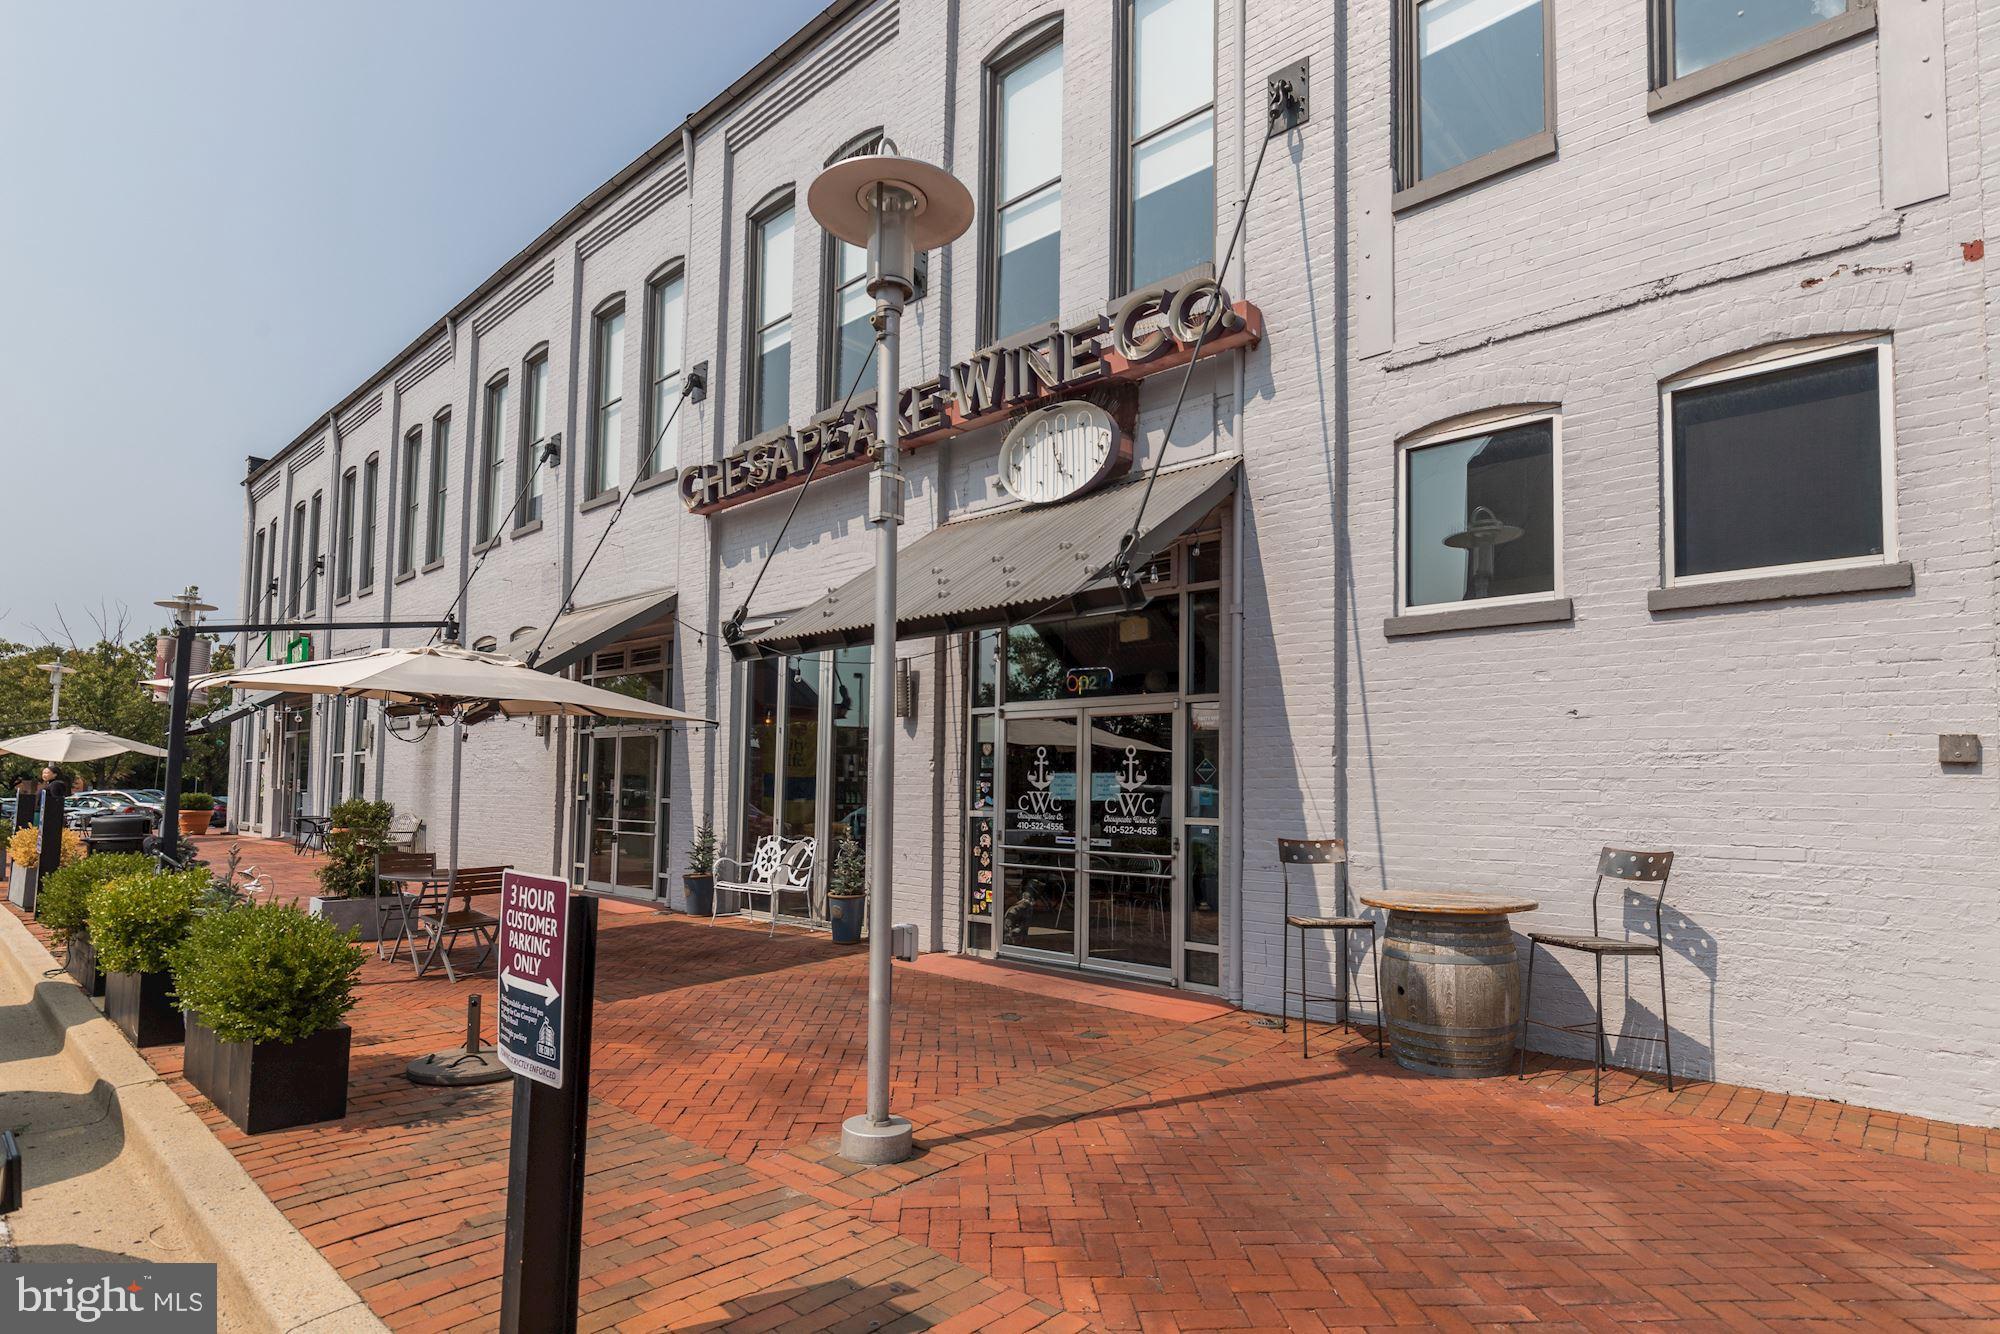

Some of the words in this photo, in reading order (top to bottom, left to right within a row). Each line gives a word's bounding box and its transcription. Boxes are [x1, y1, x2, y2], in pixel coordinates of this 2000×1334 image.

[950, 313, 1109, 416] WINE
[1018, 791, 1062, 814] CWC
[1104, 793, 1155, 817] CWC
[1016, 821, 1064, 831] 410-522-4556
[1103, 815, 1133, 825] Chesapeake
[1103, 825, 1157, 836] 410-522-4556
[510, 884, 517, 905] 3
[519, 886, 555, 913] HOUR
[506, 909, 558, 937] CUSTOMER
[508, 930, 551, 957] PARKING
[513, 953, 541, 976] ONLY
[529, 1063, 557, 1080] ENFORCED
